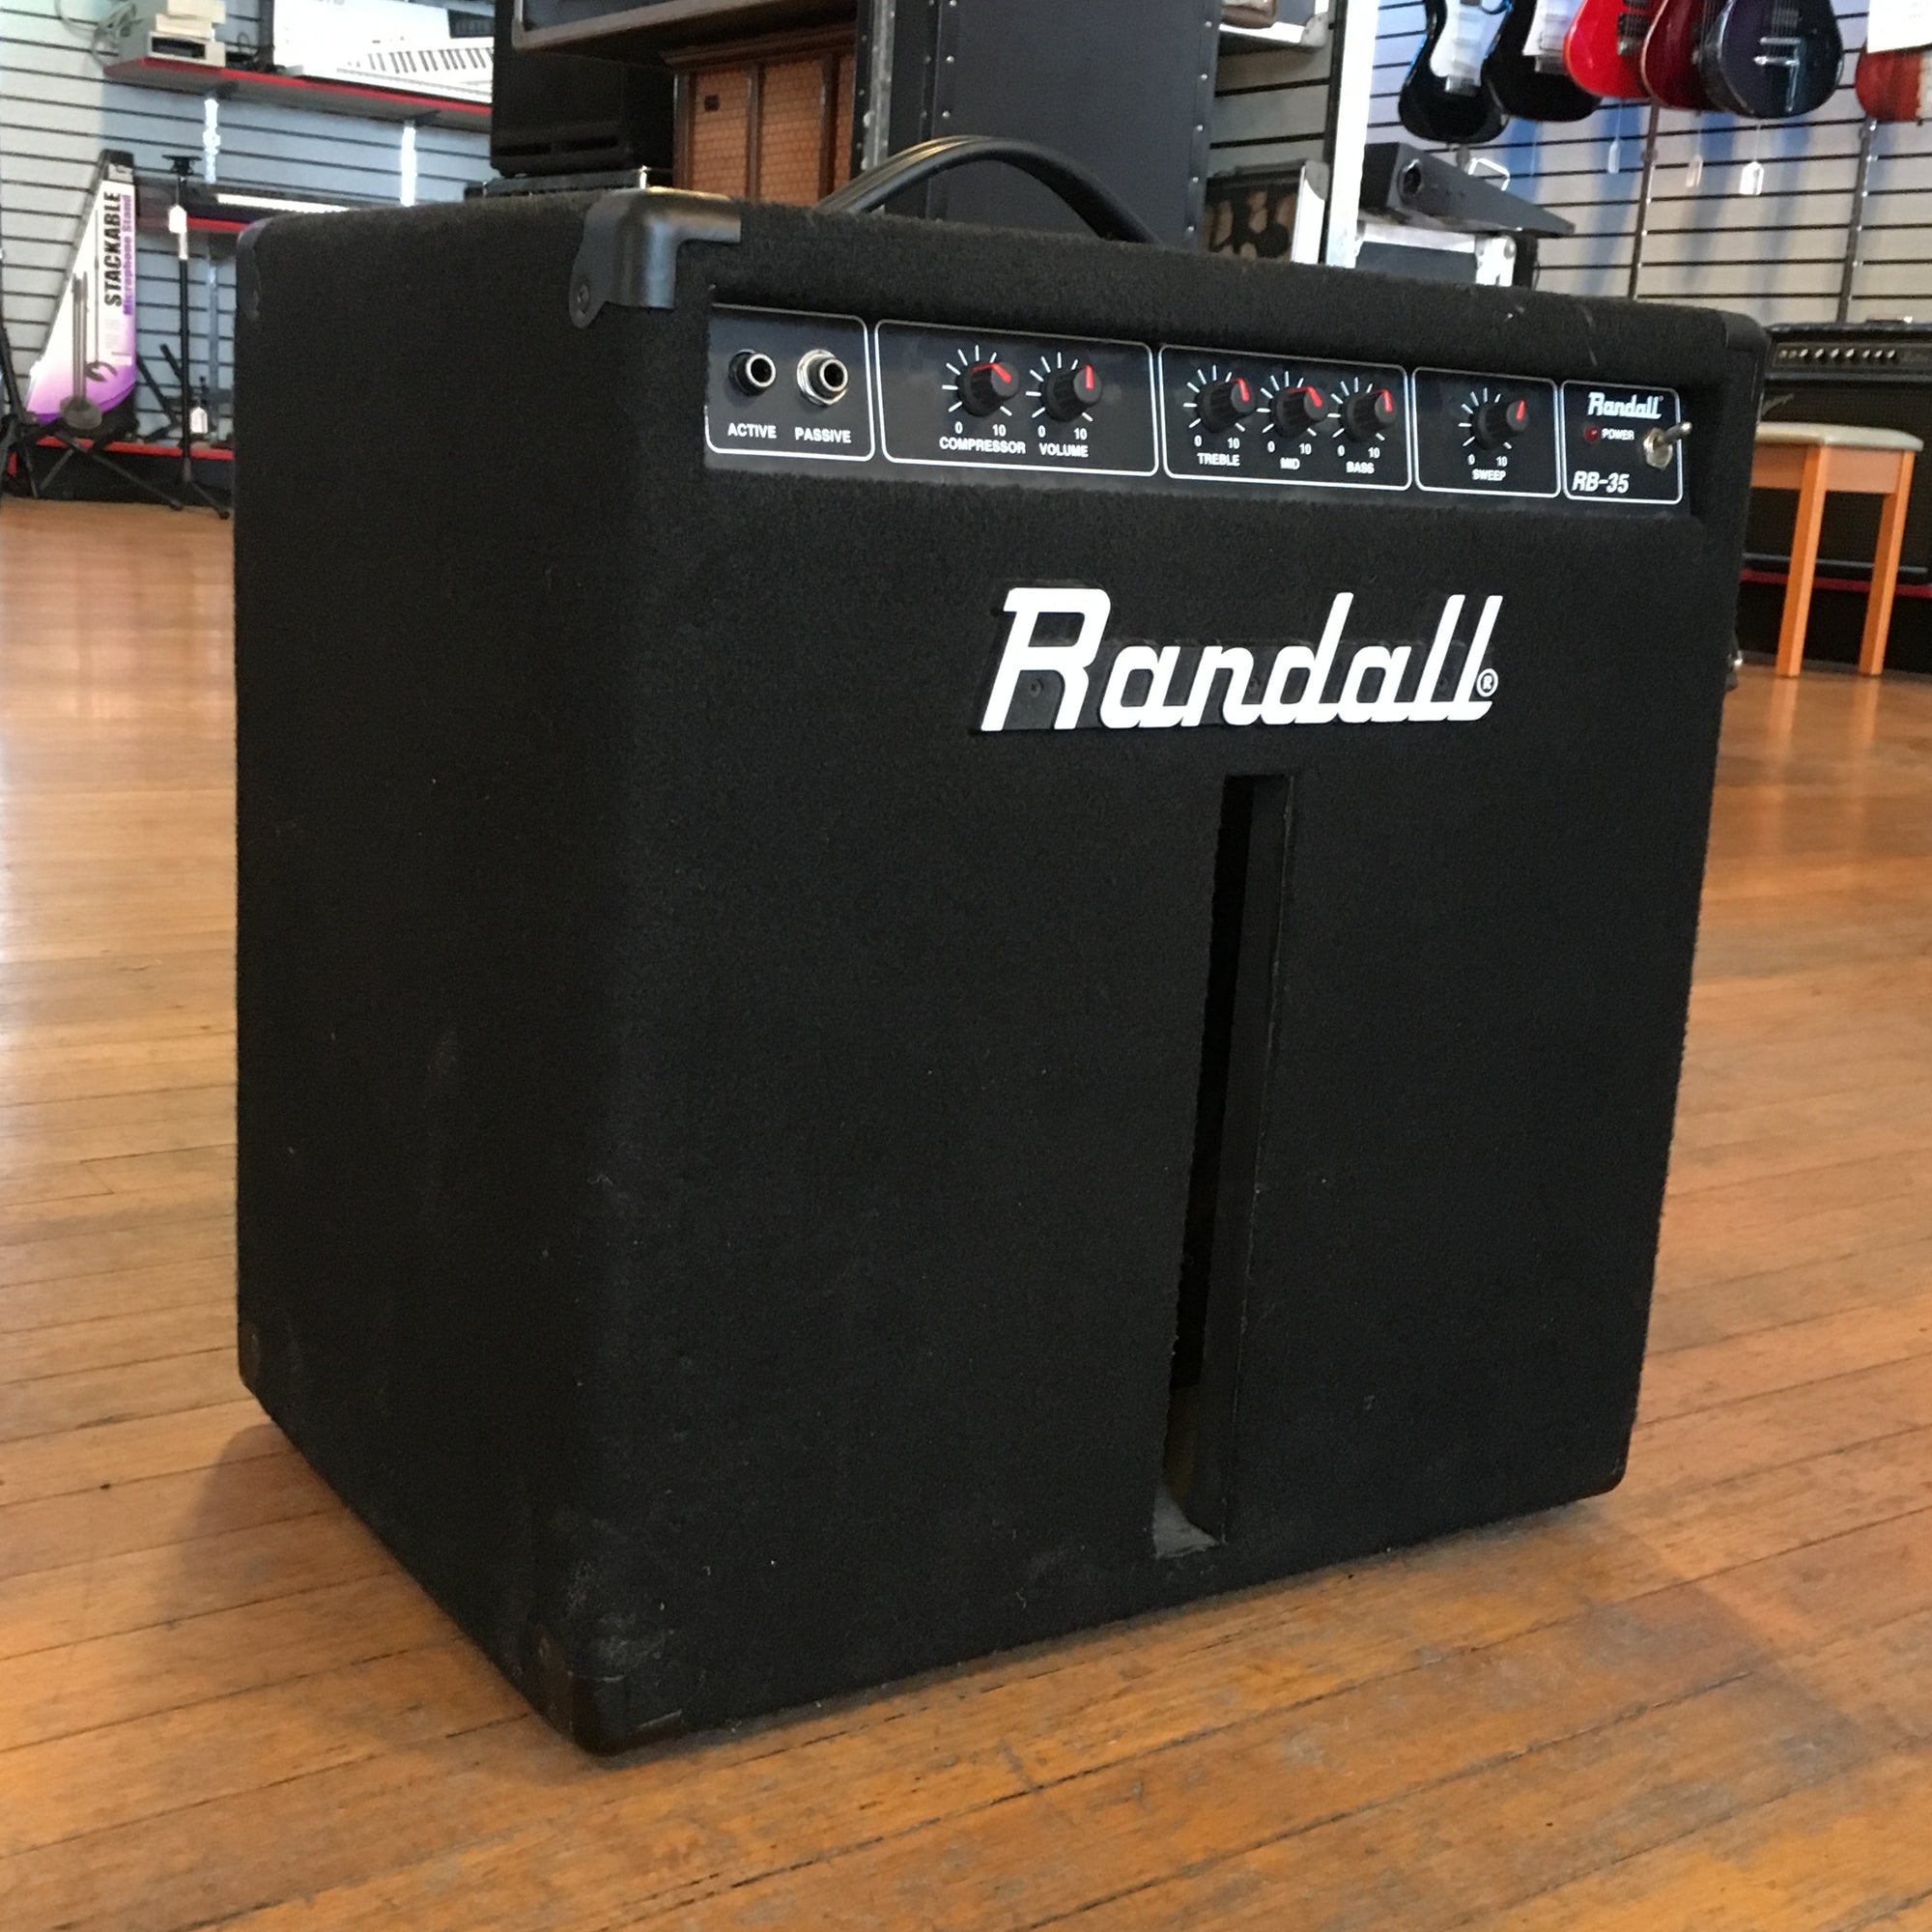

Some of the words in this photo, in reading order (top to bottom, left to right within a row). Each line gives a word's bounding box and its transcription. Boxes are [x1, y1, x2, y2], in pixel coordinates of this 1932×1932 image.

[122, 194, 133, 234] Stand
[103, 192, 122, 307] STACKABLE
[122, 236, 133, 316] Microphone
[1587, 392, 1664, 420] Randall
[727, 422, 777, 440] ACTIVE
[795, 426, 851, 444] PASSIVE
[954, 421, 963, 434] 0
[992, 423, 1007, 437] 10
[1037, 425, 1046, 438] 0
[1074, 428, 1088, 440] 10
[1602, 428, 1635, 441] POWER
[939, 436, 1026, 455] COMPRESSOR
[1038, 441, 1090, 458] VOLUME
[1194, 435, 1202, 447] 0
[1227, 437, 1240, 449] 10
[1266, 440, 1275, 453] 0
[1299, 442, 1313, 455] 10
[1337, 444, 1346, 457] 0
[1368, 446, 1381, 459] 10
[1197, 452, 1240, 468] TREBLE
[1280, 457, 1301, 470] MID
[1346, 461, 1376, 474] BASS
[1467, 453, 1475, 466] 0
[1496, 454, 1508, 468] 10
[1472, 468, 1507, 482] SWEEP
[1572, 470, 1630, 494] RB-35
